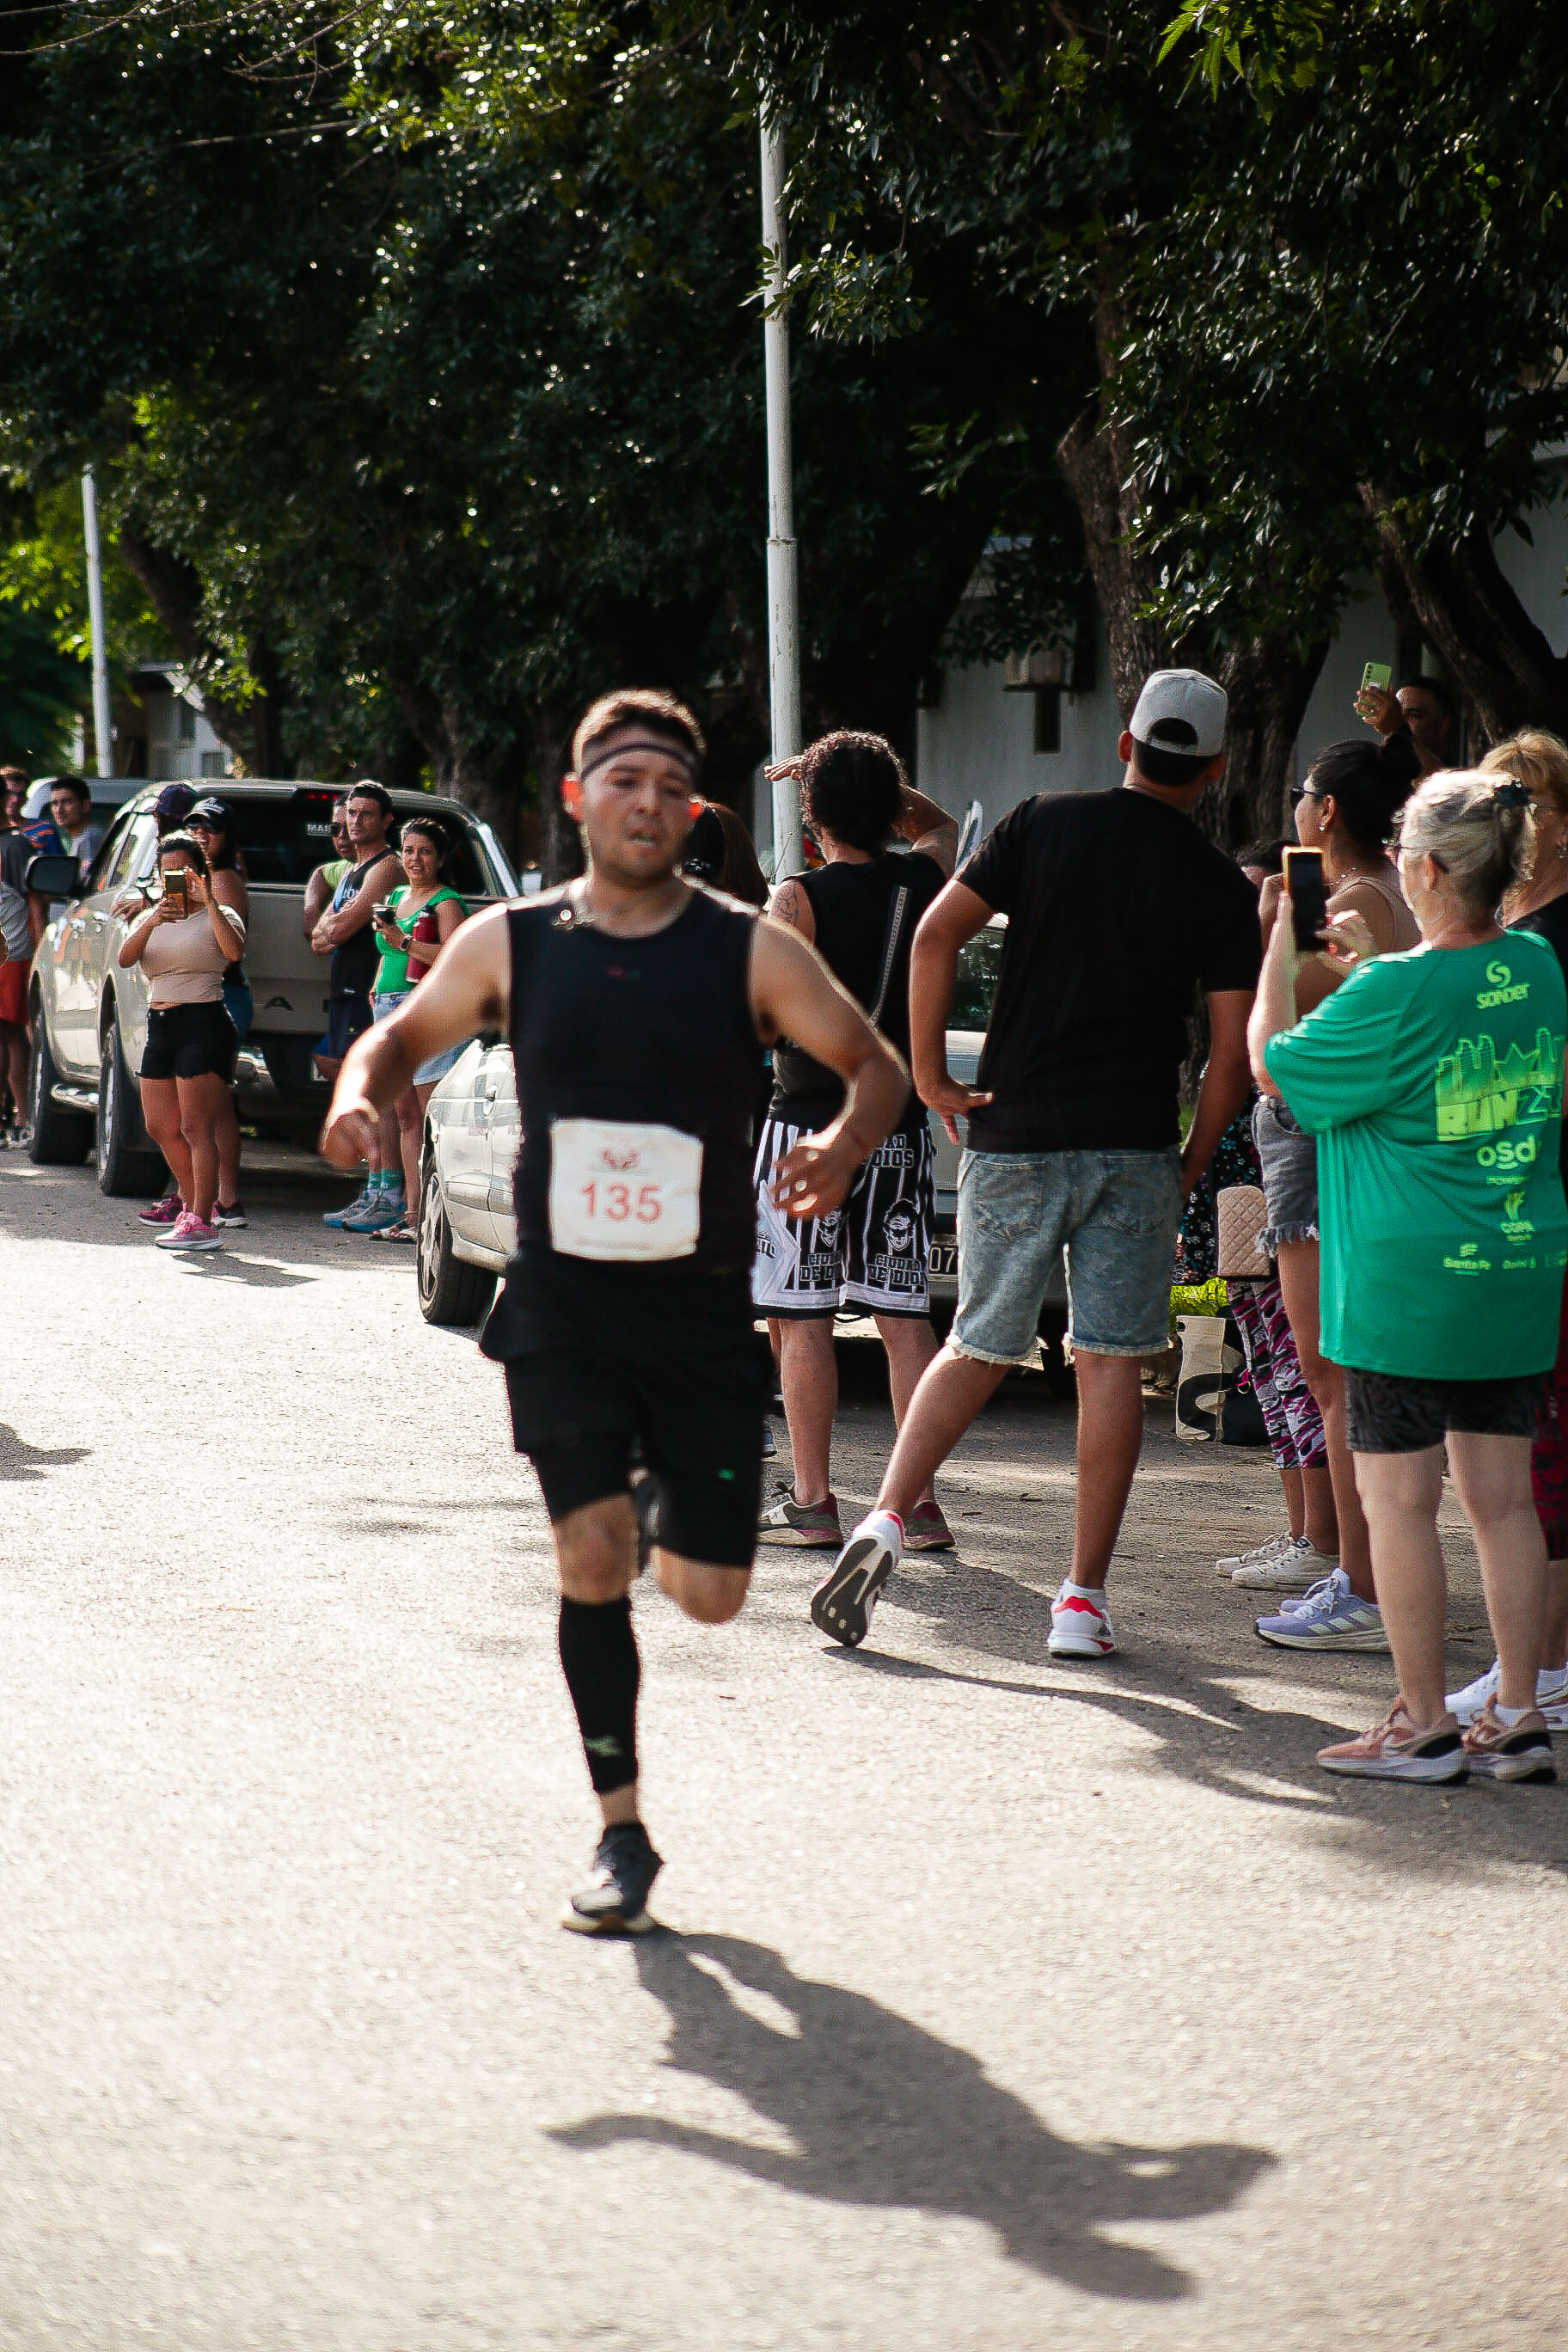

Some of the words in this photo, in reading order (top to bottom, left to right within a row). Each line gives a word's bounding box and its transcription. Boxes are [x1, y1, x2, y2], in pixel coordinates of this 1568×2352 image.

[872, 1148, 914, 1168] DIOS
[1477, 1133, 1536, 1167] osd
[579, 1181, 664, 1223] 135
